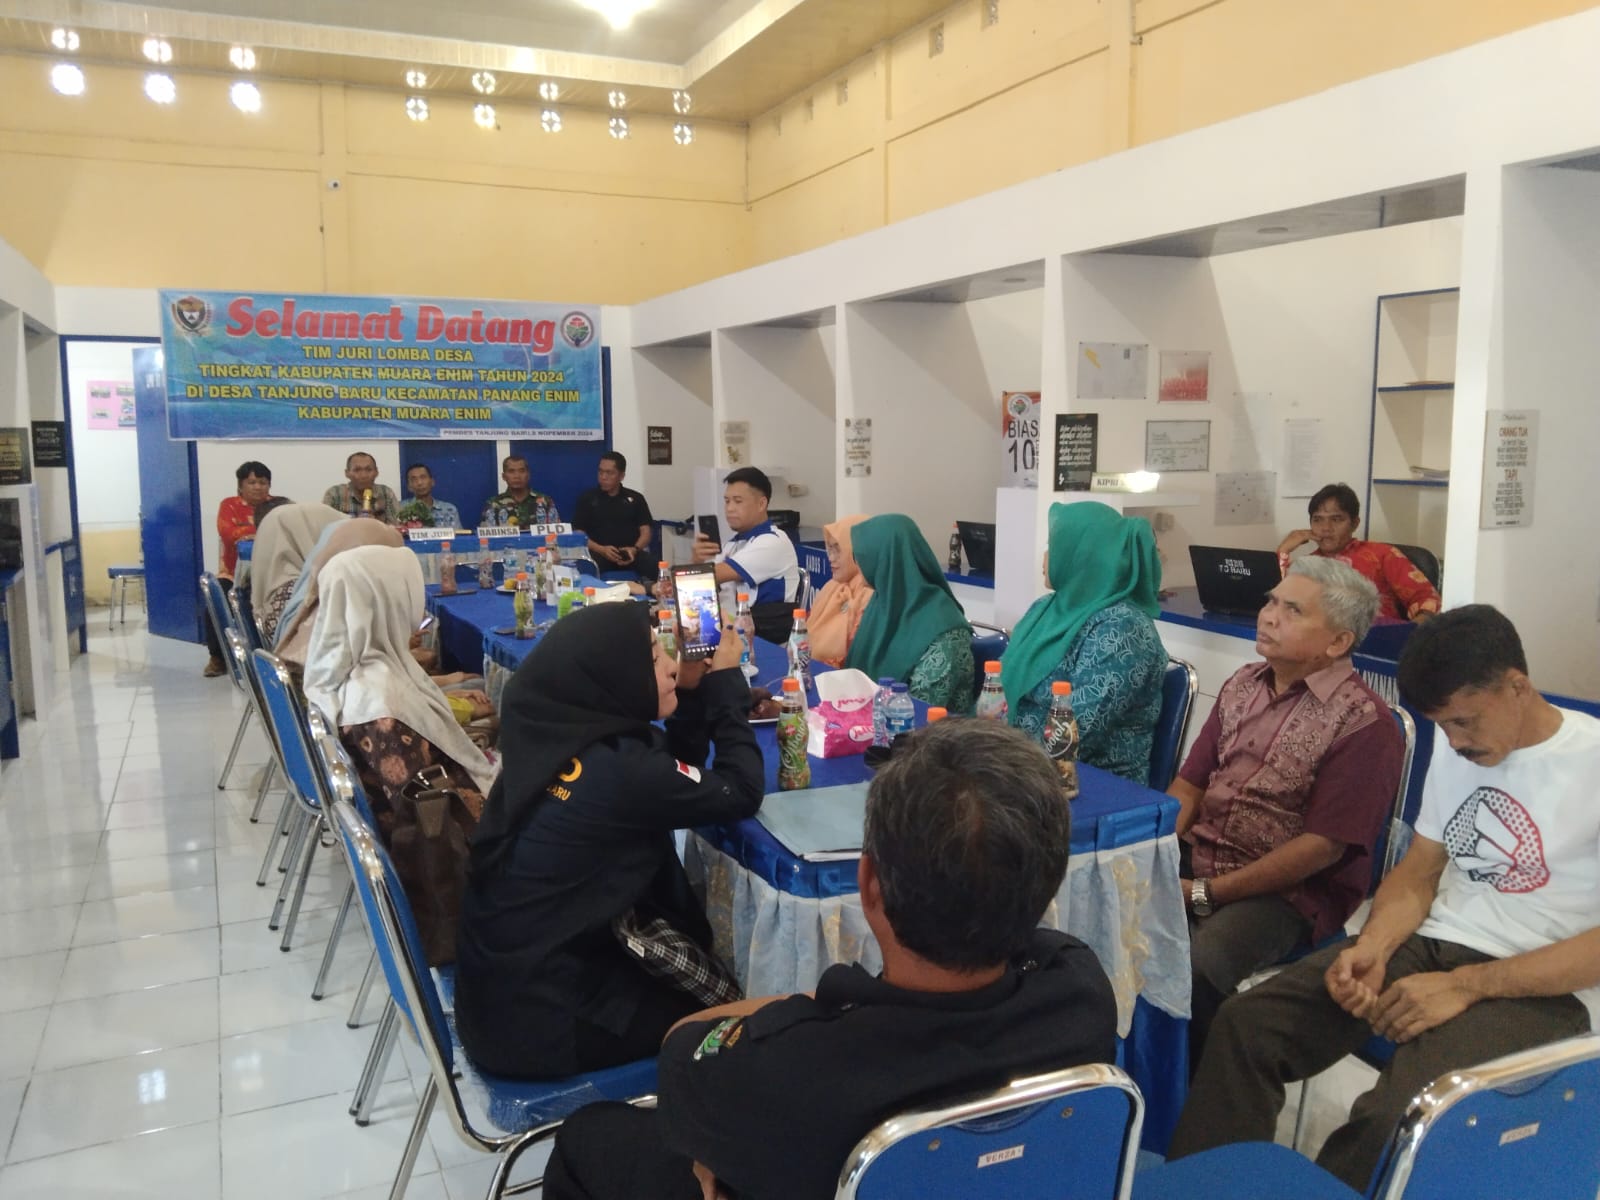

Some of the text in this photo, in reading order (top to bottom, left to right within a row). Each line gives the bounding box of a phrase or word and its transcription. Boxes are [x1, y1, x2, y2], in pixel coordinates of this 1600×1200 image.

[225, 296, 556, 356] Selamat Datang
[303, 346, 474, 362] TIM JURI LOMBA DESA
[200, 364, 564, 383] TINGKAT KABUPATEN MUARA ENIM TAHUN 2024
[186, 385, 580, 403] DI DESA TANJUNG BARU KECAMATAN PANANG ENIM
[298, 406, 492, 421] KABUPATEN MUARA ENIM
[1008, 420, 1040, 438] BIAS
[1008, 439, 1035, 473] 10
[479, 527, 520, 537] BABINSA
[537, 524, 565, 535] PLD
[1352, 667, 1400, 706] AYANAN
[547, 784, 571, 800] ARU
